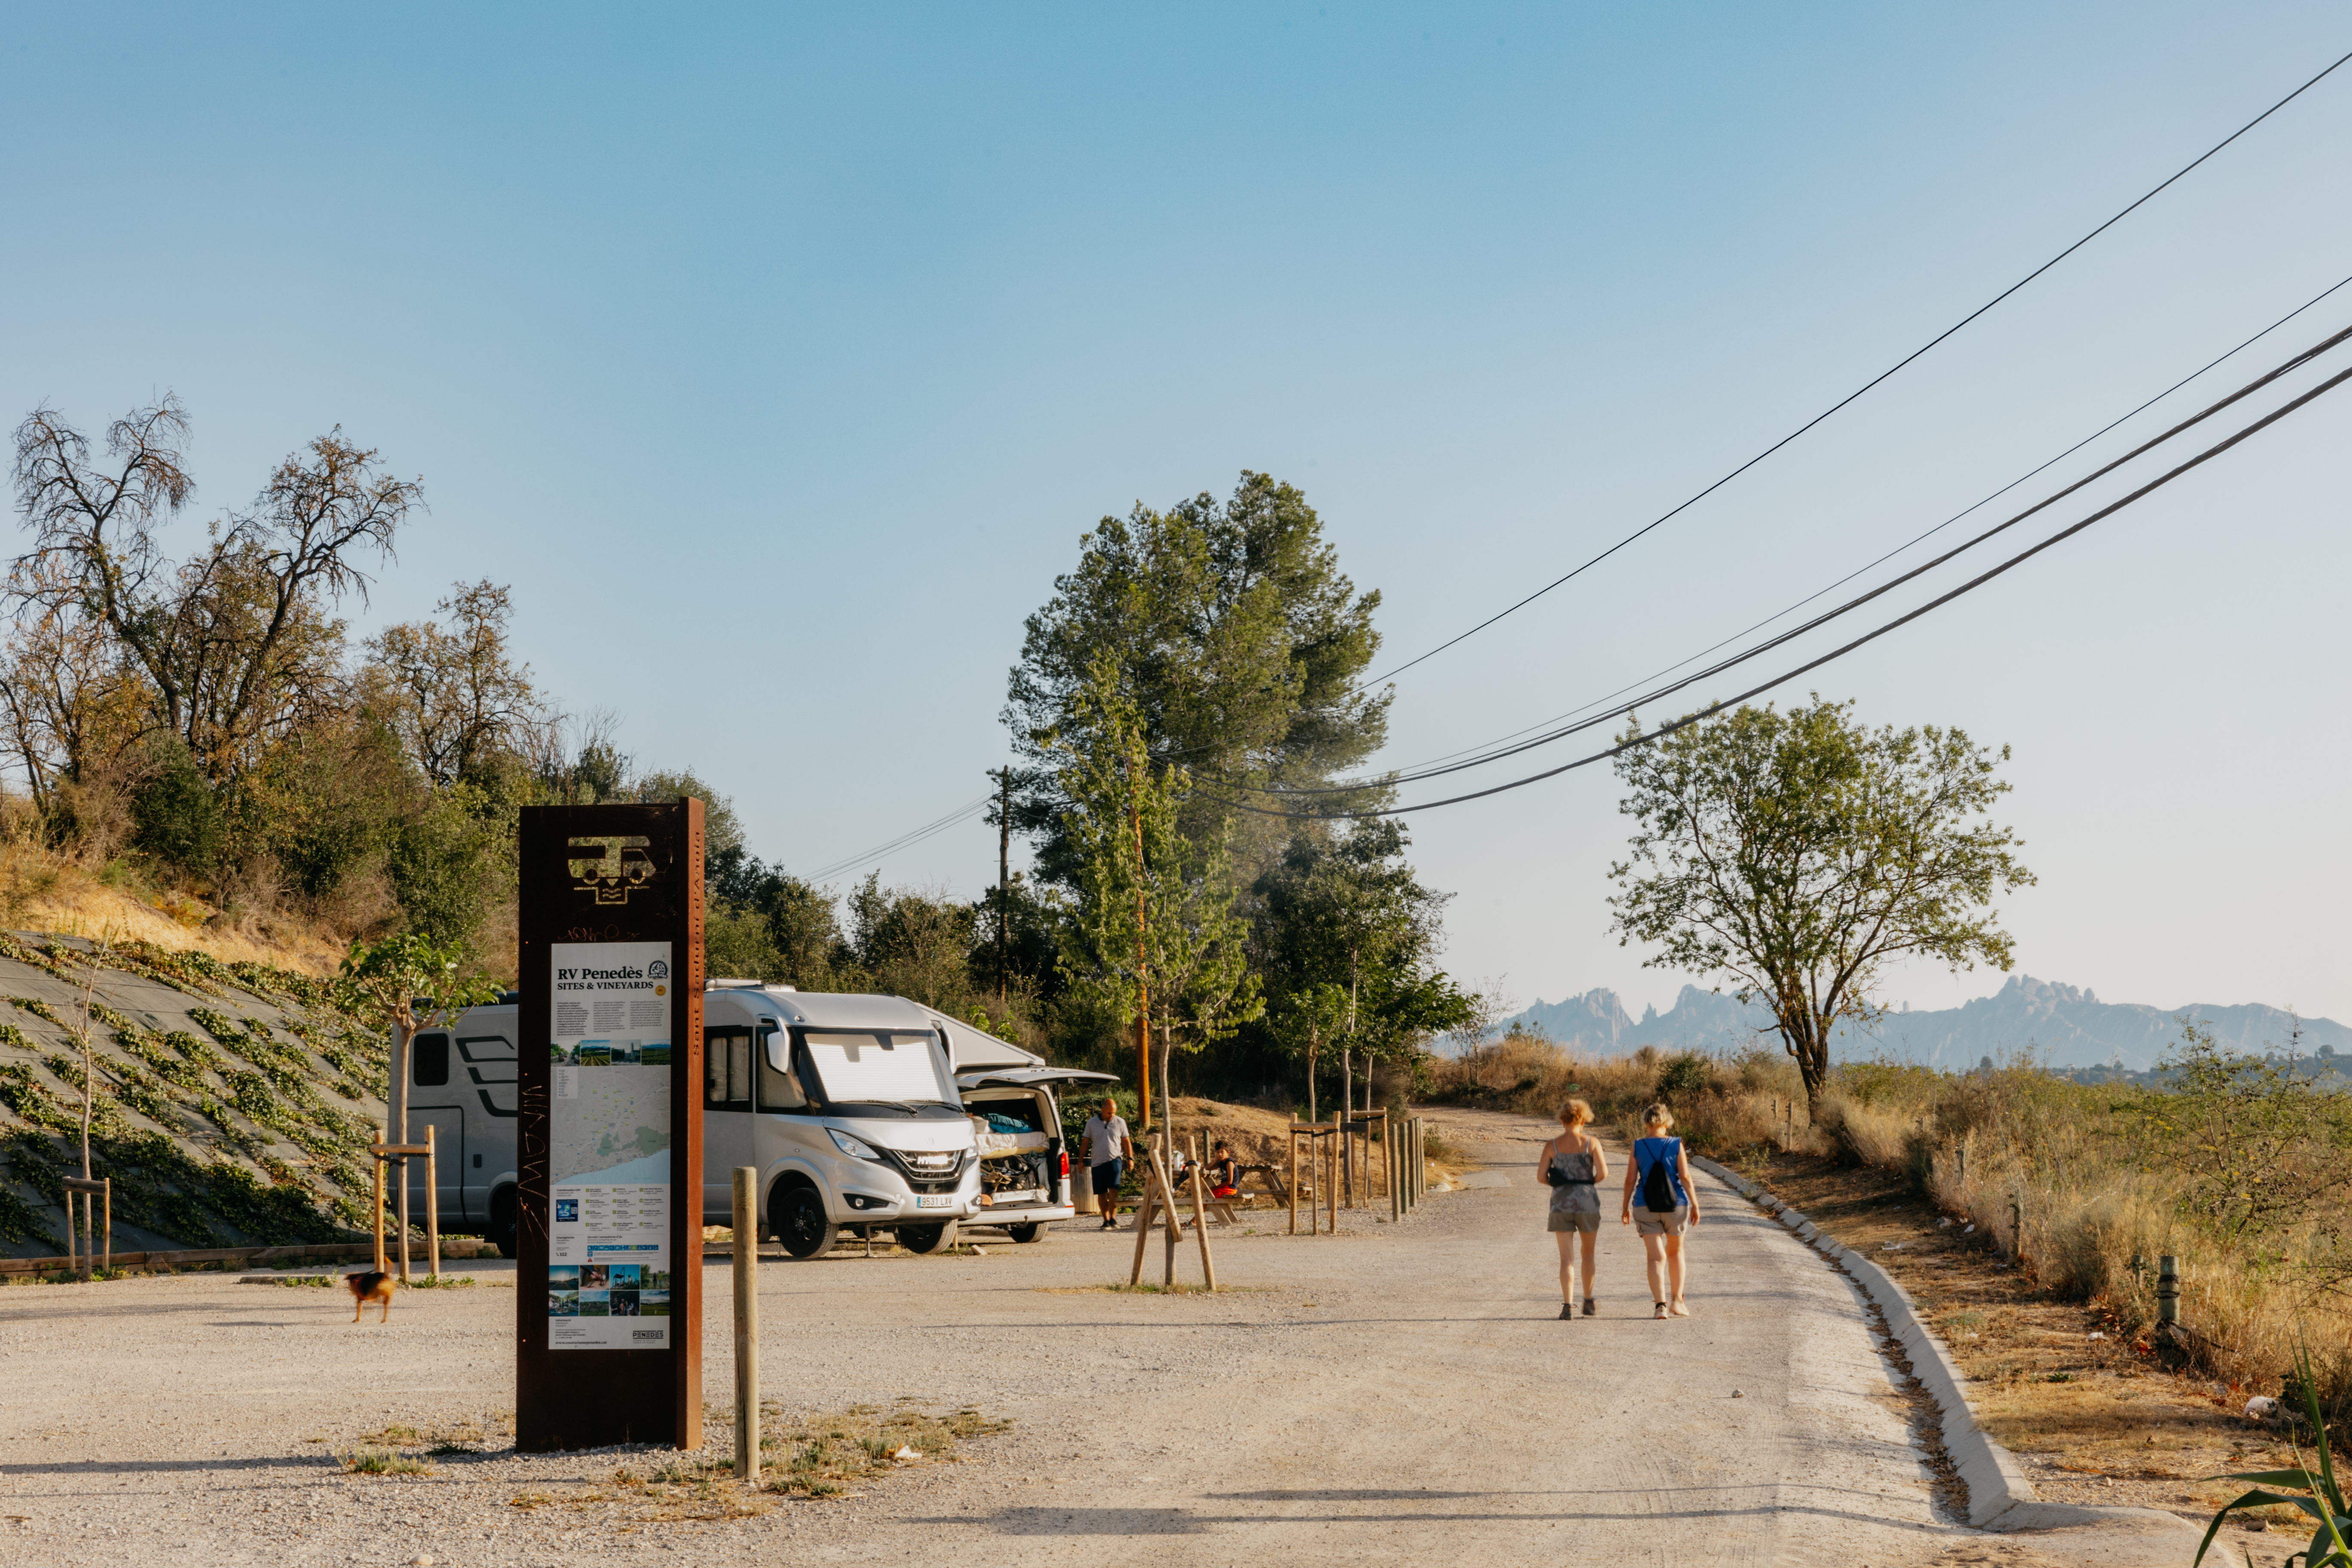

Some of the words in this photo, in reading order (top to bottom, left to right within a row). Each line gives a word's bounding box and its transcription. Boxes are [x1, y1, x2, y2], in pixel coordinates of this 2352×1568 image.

[557, 969, 578, 980] RV
[582, 966, 643, 979] Penedès
[557, 982, 585, 990] SITES
[586, 982, 594, 990] &
[597, 981, 654, 990] VINEYARDS
[922, 1197, 938, 1206] 9531
[940, 1197, 952, 1205] LXV
